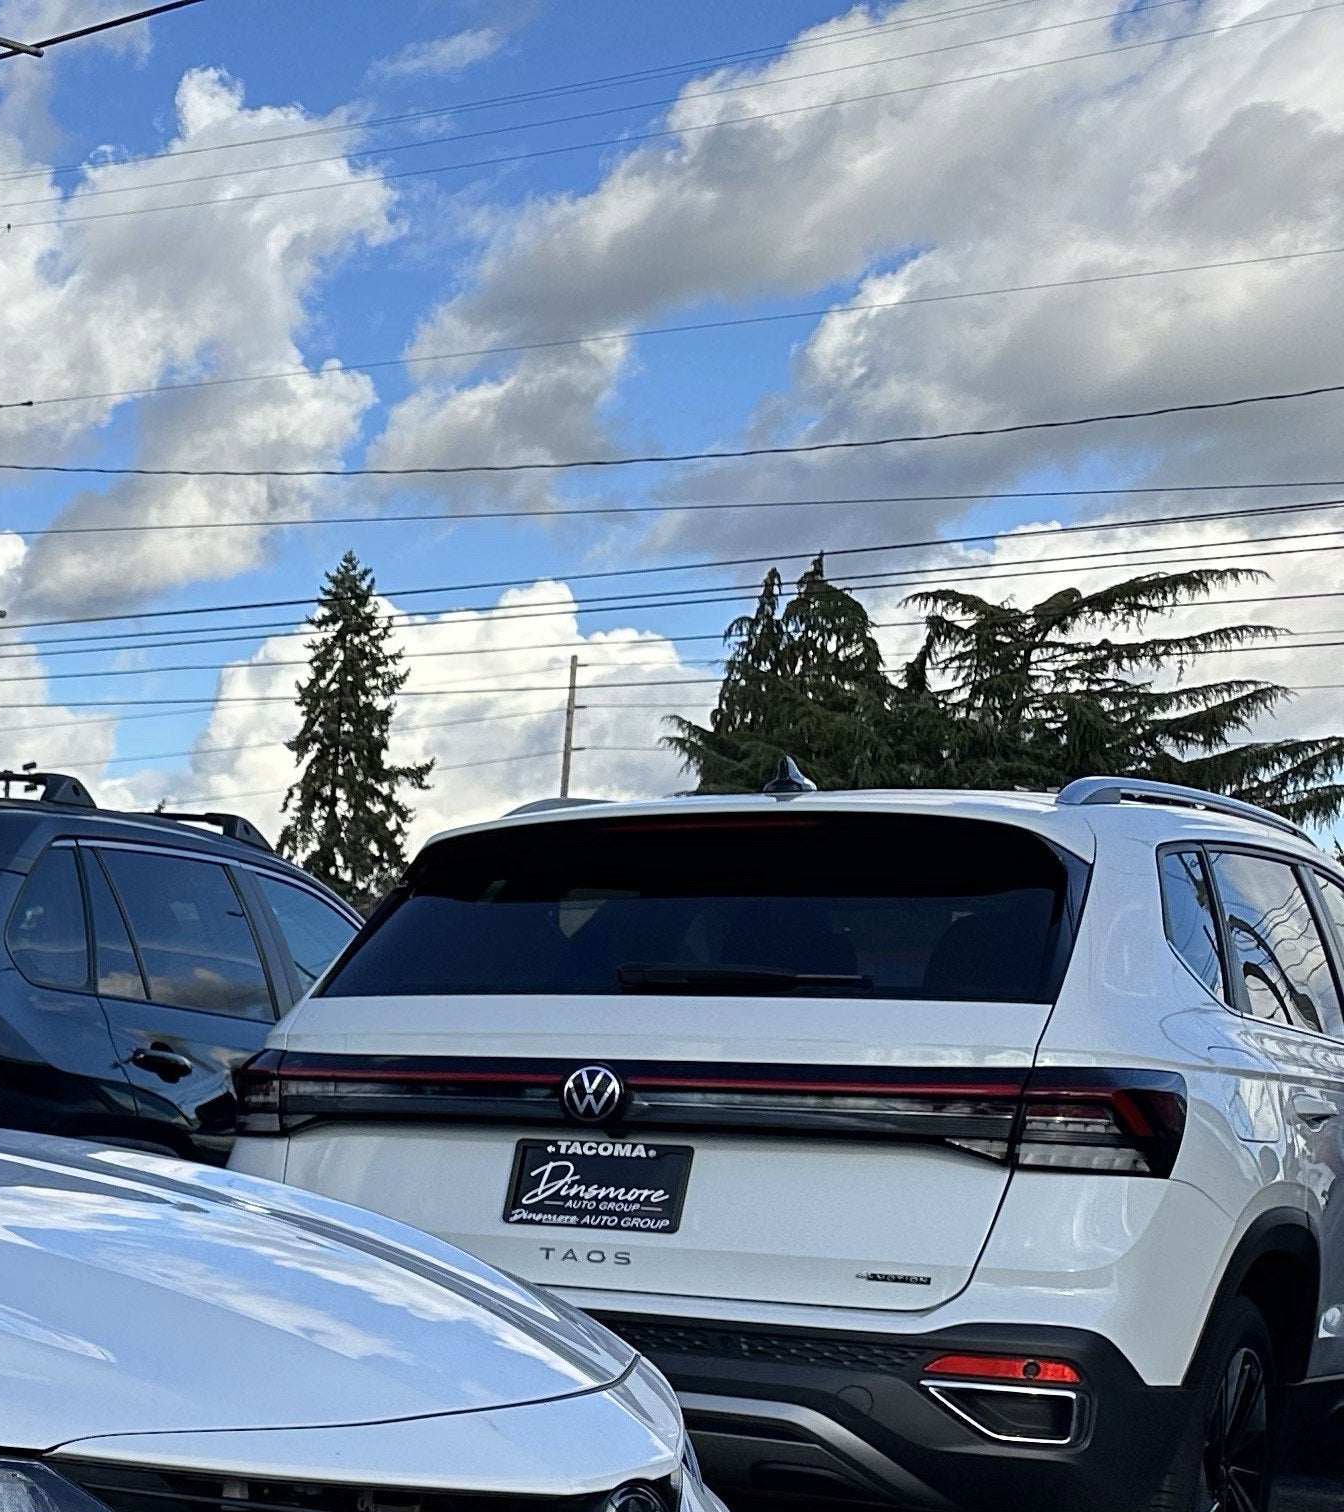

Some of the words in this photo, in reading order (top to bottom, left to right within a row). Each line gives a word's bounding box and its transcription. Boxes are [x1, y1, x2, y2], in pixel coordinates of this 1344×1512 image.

[556, 1140, 648, 1158] TACOMA
[521, 1160, 670, 1205] Dinsmore
[564, 1200, 596, 1211] AUTO
[599, 1201, 641, 1213] GROUP
[580, 1215, 618, 1229] AUTO
[620, 1217, 670, 1231] GROUP
[539, 1246, 633, 1267] TAOS
